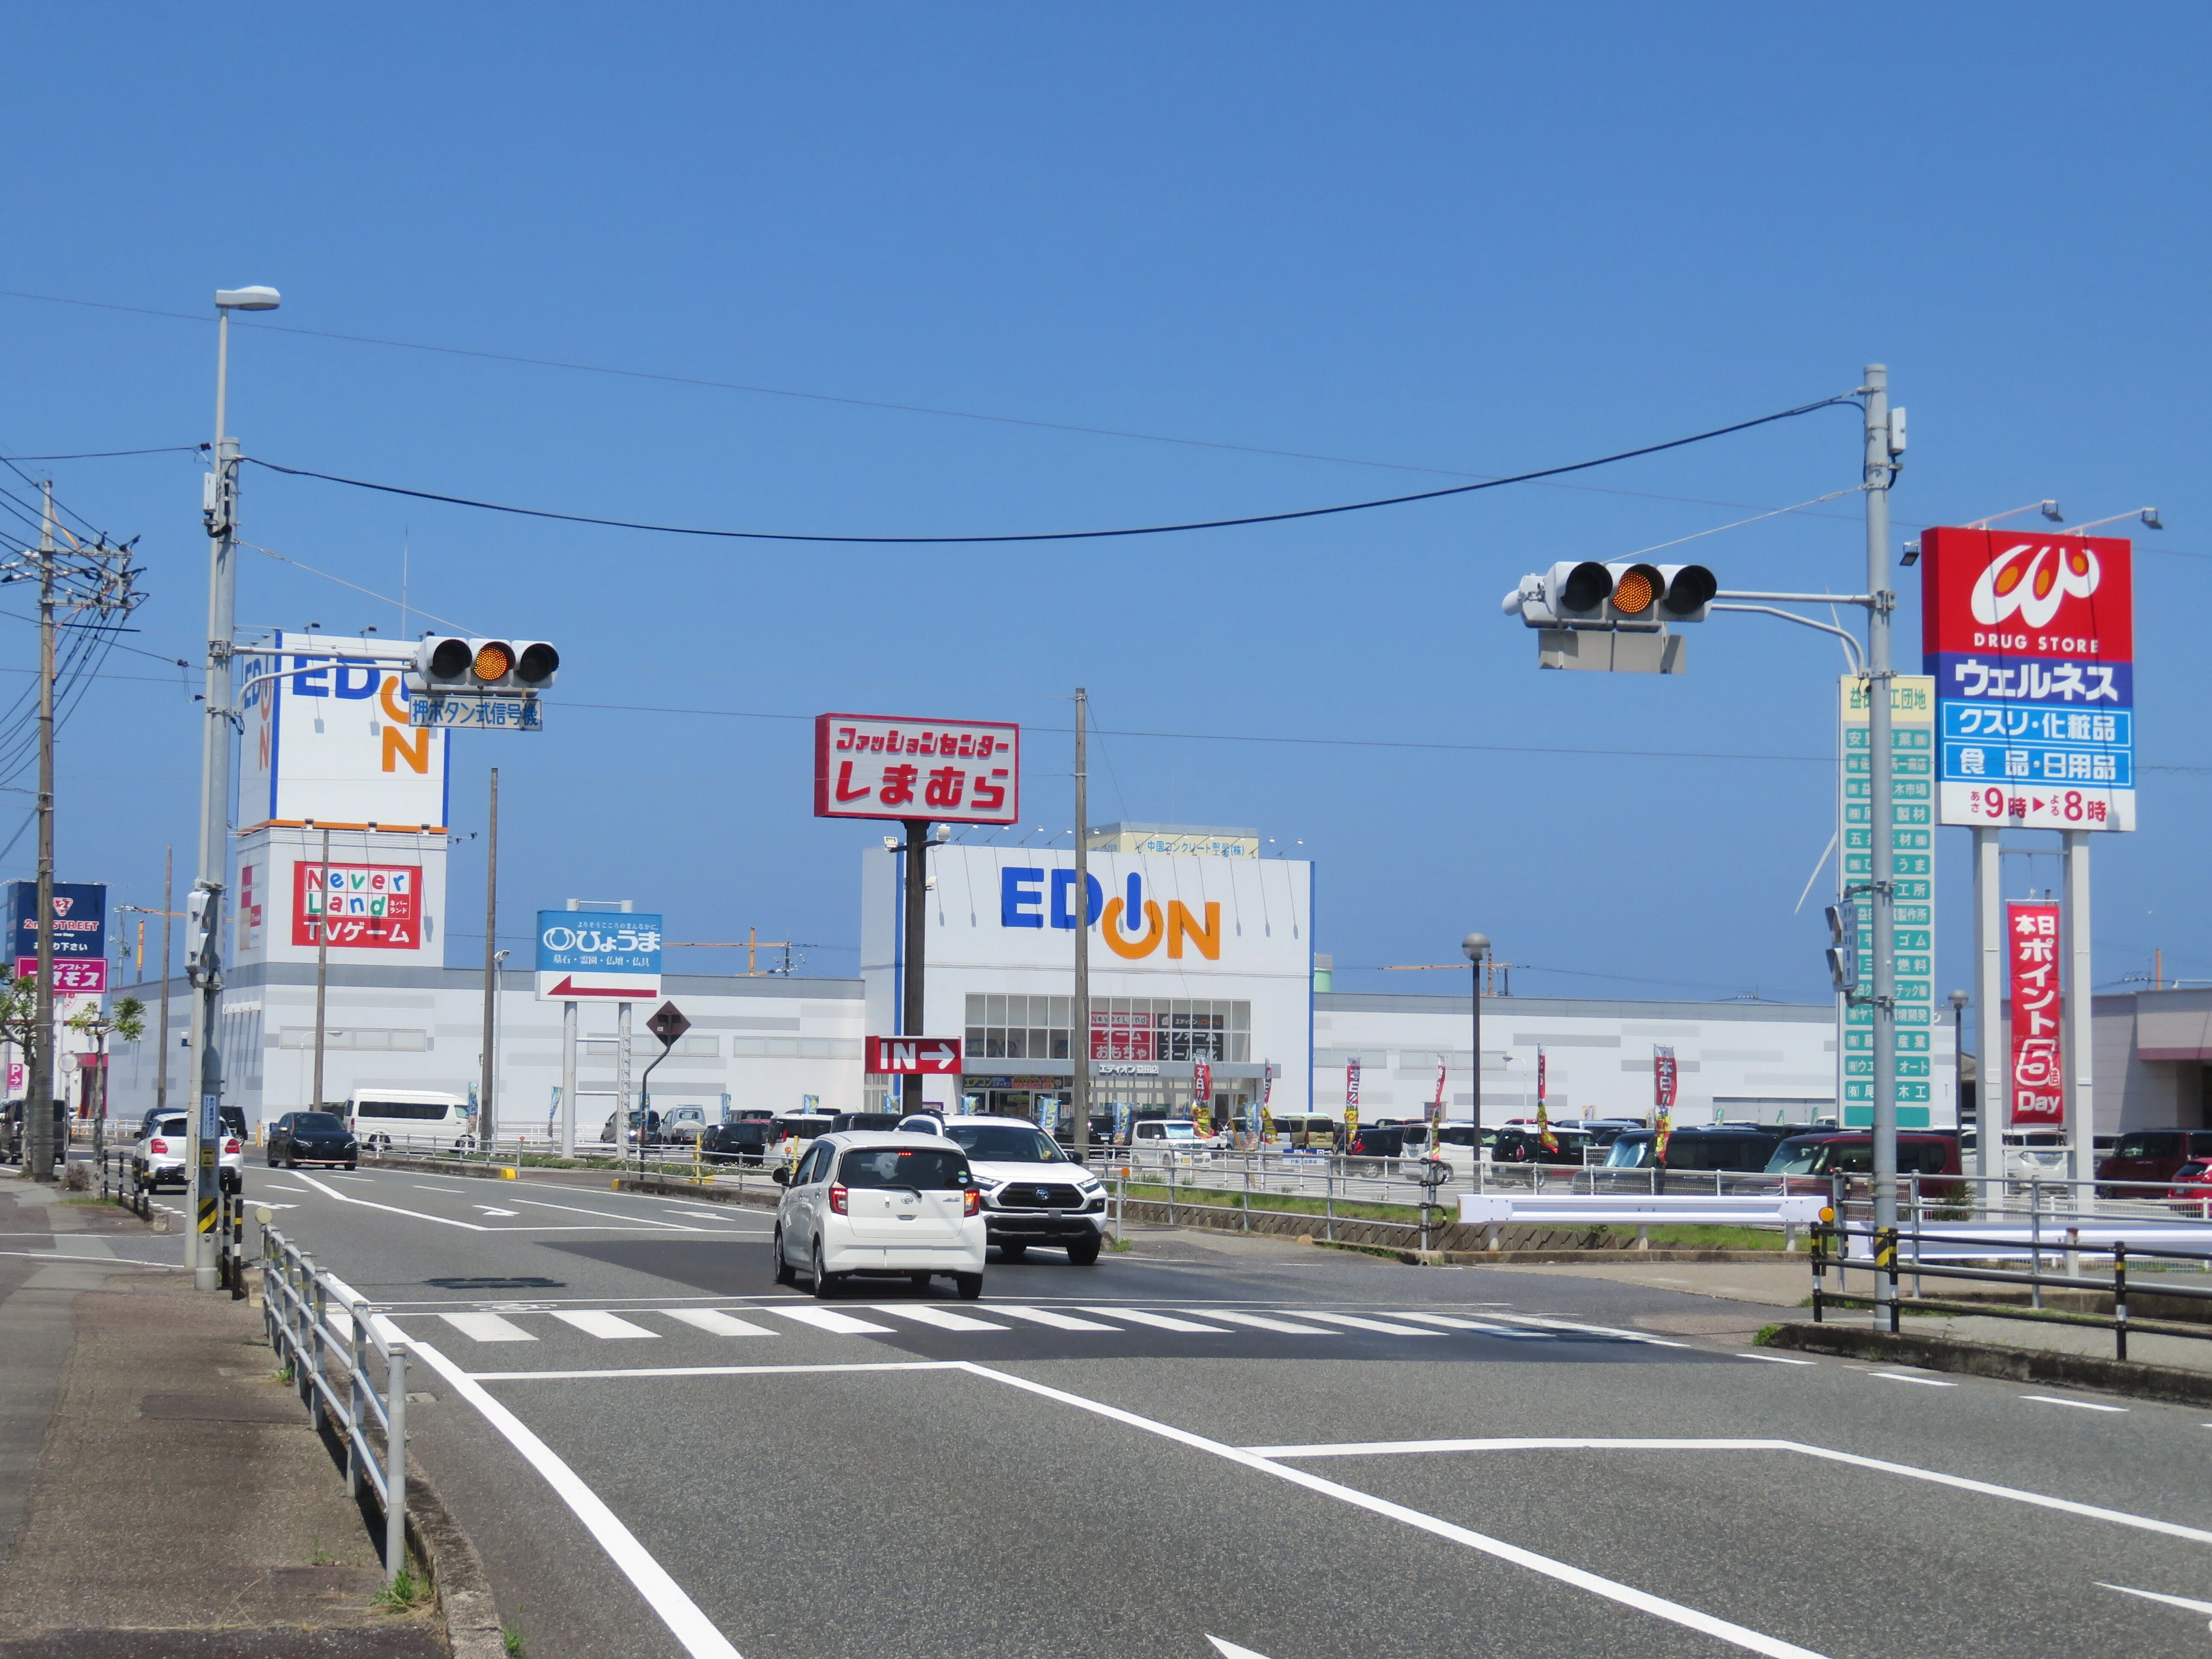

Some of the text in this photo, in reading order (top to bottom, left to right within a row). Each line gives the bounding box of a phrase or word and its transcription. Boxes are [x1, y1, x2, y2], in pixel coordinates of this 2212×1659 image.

[1974, 633, 2099, 653] DRUG STORE
[1955, 659, 2118, 701] ウェルネス
[1850, 687, 1926, 710] 益田工団地
[291, 649, 428, 774] EDON
[413, 699, 538, 726] 押ボタン式信号機
[1959, 708, 2115, 742] クスリ・化粧品
[837, 728, 1008, 757] ファッションセンター
[836, 761, 1008, 809] しまむら
[1984, 788, 2026, 819] 9時
[2064, 791, 2106, 822] 8時
[308, 869, 405, 891] Never
[309, 893, 386, 916] Land
[1001, 866, 1221, 960] EDION
[24, 919, 99, 931] 2n STREET
[303, 921, 410, 943] TVゲーム
[2014, 915, 2055, 935] 本日
[576, 930, 661, 952] ひょうま
[553, 954, 650, 967] 墓石・霊園・仏壇・仏具
[27, 970, 99, 987] スモス
[2018, 937, 2056, 1035] ポイント
[880, 1042, 916, 1069] IN
[12, 1065, 21, 1075] P
[1099, 1064, 1159, 1074] エディオン益田店
[1848, 1085, 1926, 1098] ㈲尾木工
[2017, 1091, 2061, 1114] Day
